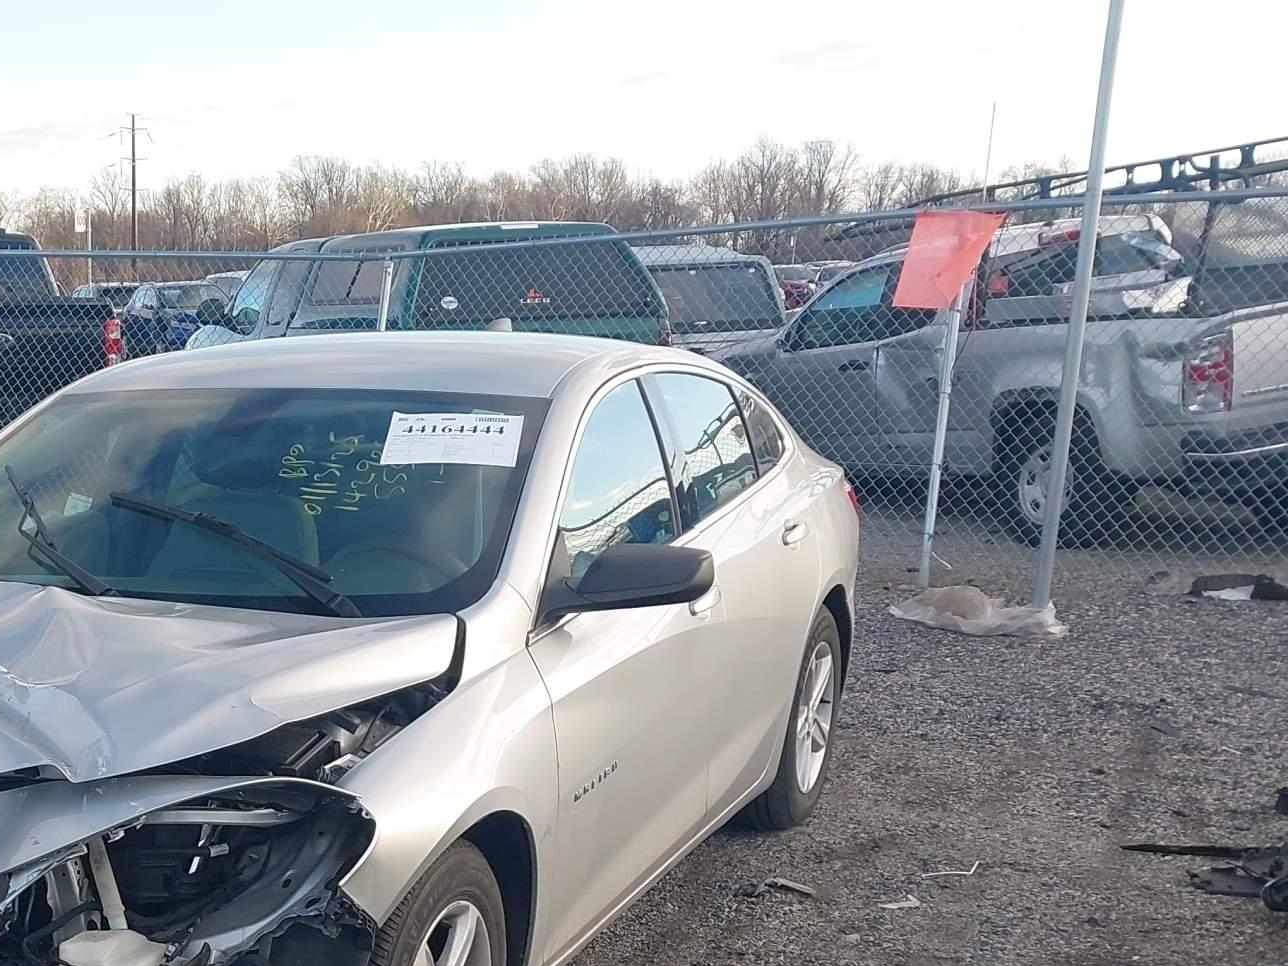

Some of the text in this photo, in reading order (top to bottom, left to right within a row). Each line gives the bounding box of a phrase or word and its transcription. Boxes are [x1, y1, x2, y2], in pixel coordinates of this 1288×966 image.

[520, 297, 551, 305] LEER
[402, 423, 505, 435] 44164444
[573, 760, 618, 803] MALIBU
